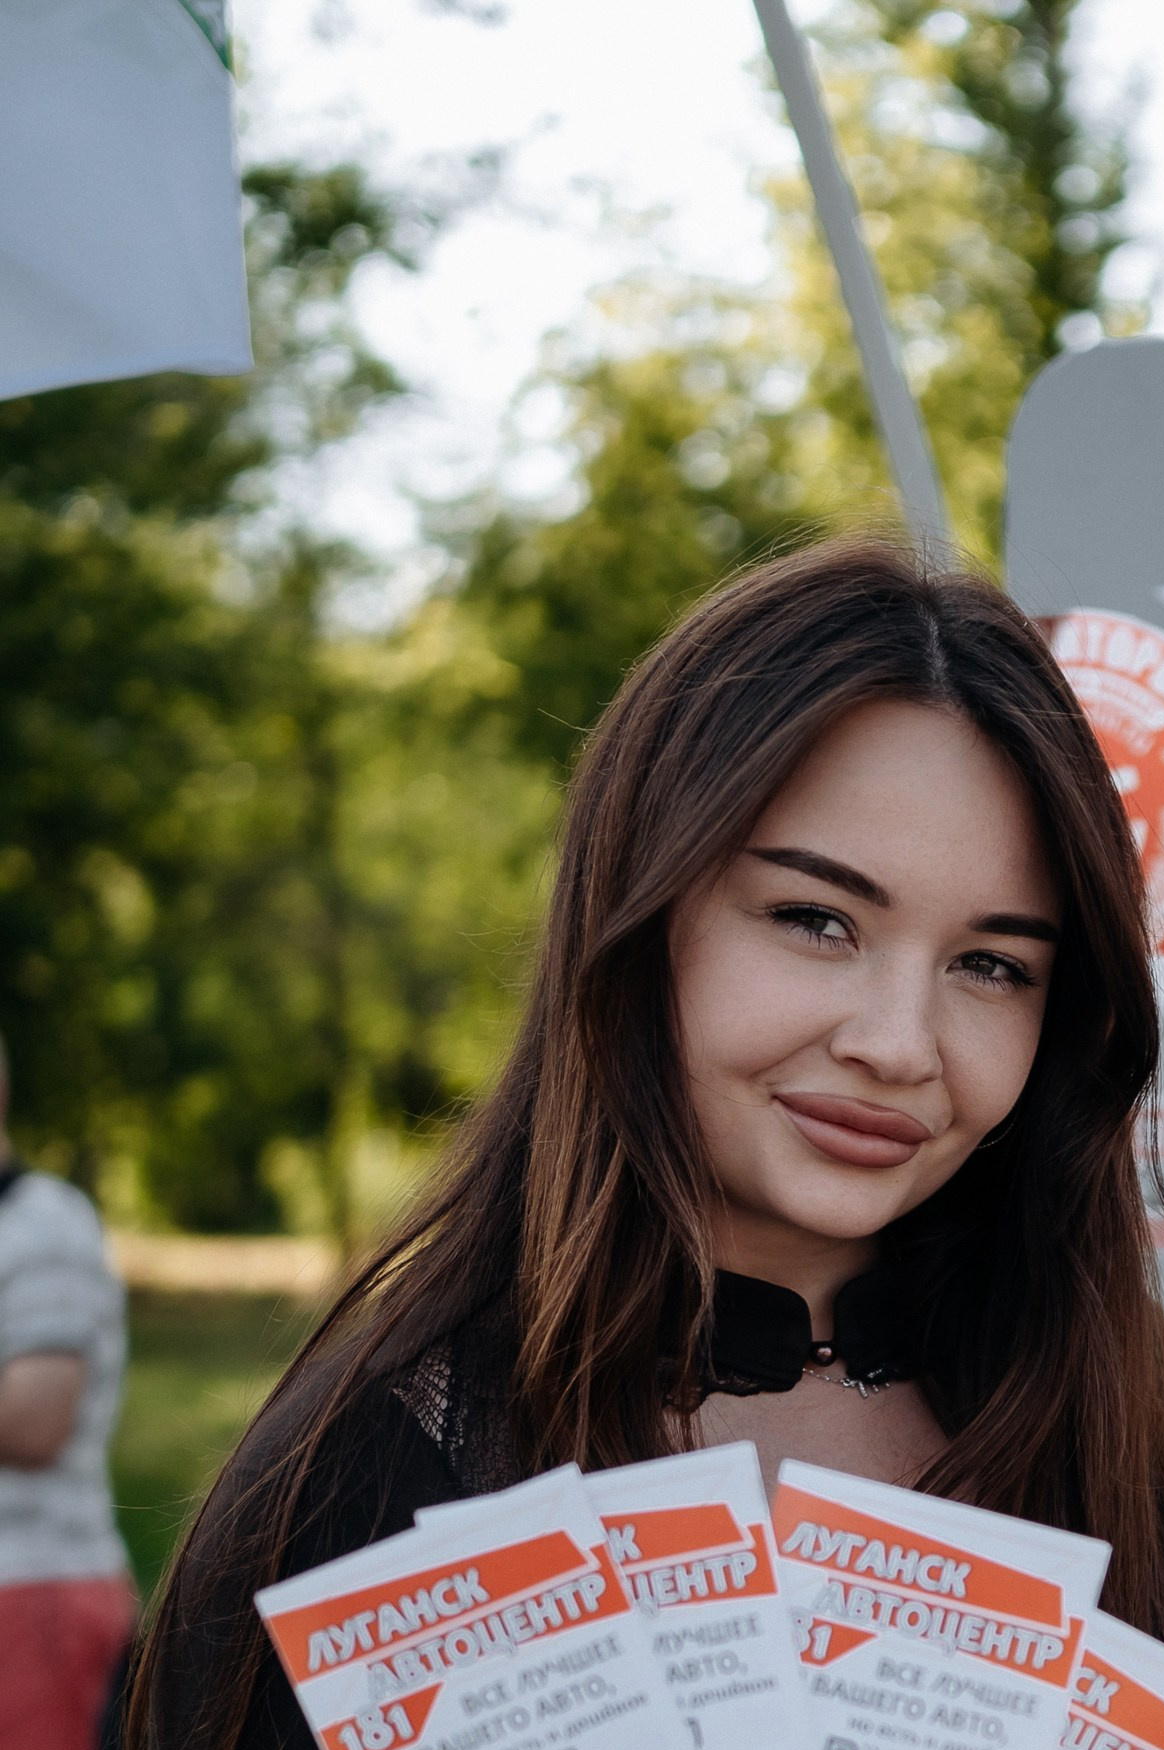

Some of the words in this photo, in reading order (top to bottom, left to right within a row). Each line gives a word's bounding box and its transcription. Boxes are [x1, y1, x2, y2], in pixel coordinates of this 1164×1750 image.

[629, 1551, 757, 1617] ЦЕНТР
[782, 1521, 972, 1598] ЛУГАНСК
[307, 1566, 490, 1671] ЛУГАНСК
[369, 1573, 607, 1701] АВТОЦЕНТР
[790, 1607, 833, 1660] 81
[812, 1581, 1064, 1670] АВТОЦЕНТР
[460, 1679, 508, 1718] ВСЕ
[518, 1633, 622, 1693] ЛУЧШЕЕ
[877, 1656, 926, 1690] ВСЕ
[931, 1671, 1039, 1716] ЛУЧШЕЕ
